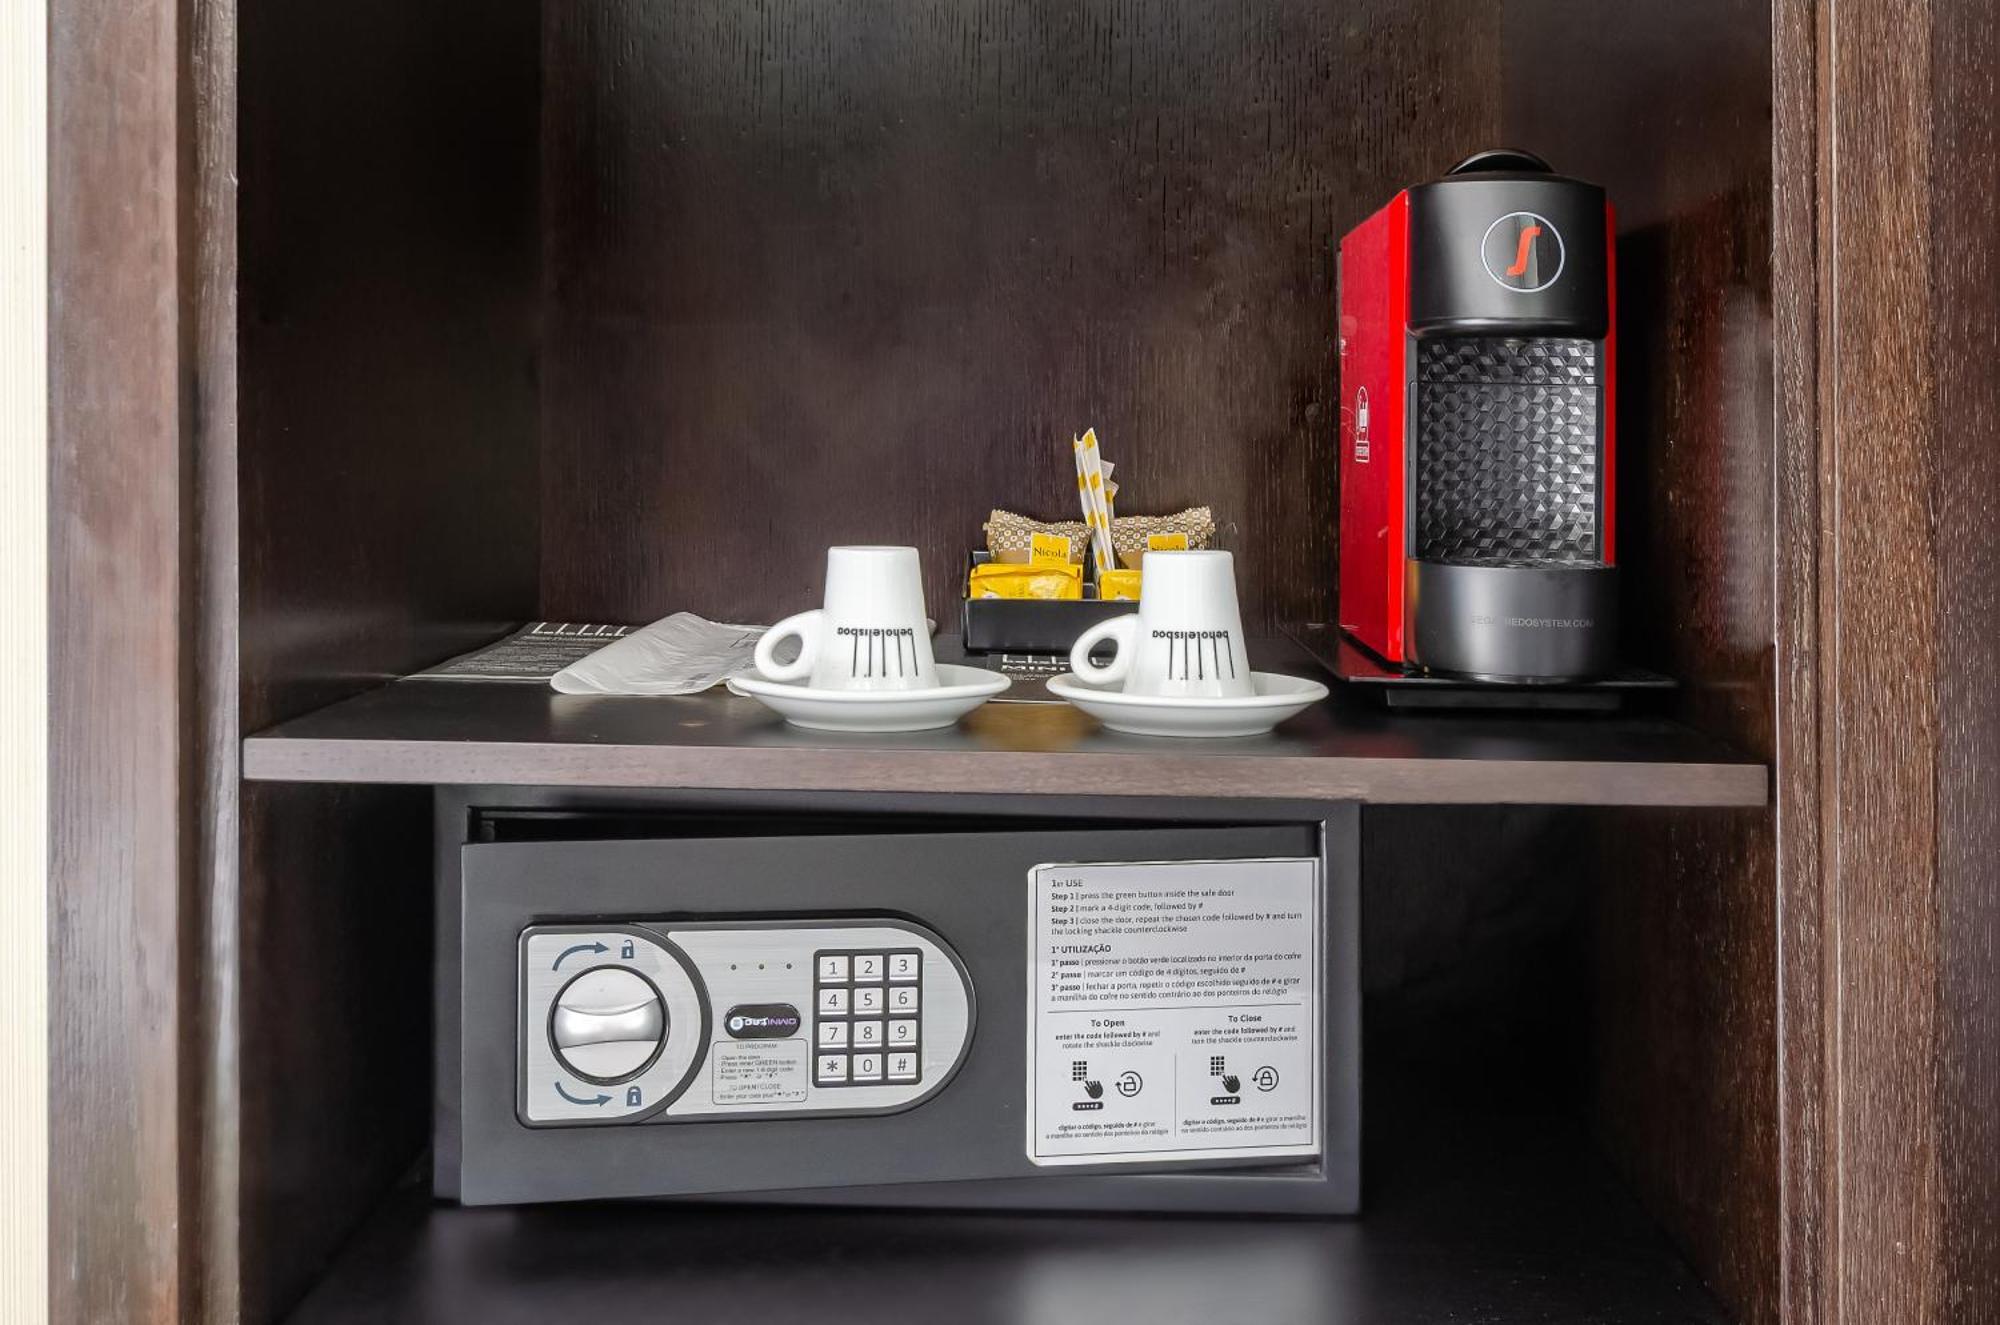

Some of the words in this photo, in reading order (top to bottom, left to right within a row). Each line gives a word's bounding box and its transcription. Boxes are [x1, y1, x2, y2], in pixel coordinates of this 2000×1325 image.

[1034, 547, 1067, 558] Nicola
[1108, 904, 1131, 912] 4-digit
[1136, 916, 1159, 924] repeat
[1256, 913, 1264, 921] by
[1065, 927, 1092, 936] locking
[1061, 944, 1111, 954] UTILIZAÇÃO
[1085, 958, 1120, 966] pressionar
[1255, 954, 1272, 962] porta
[829, 962, 837, 975] 1
[864, 960, 872, 973] 2
[899, 960, 907, 972] 3
[1129, 969, 1153, 977] código
[1201, 967, 1228, 975] seguido
[1060, 984, 1080, 992] passo
[1140, 981, 1163, 990] repetir
[1172, 980, 1195, 988] código
[1197, 979, 1231, 987] escolhido
[1131, 991, 1157, 999] sentido
[1159, 990, 1191, 998] contrário
[1217, 989, 1249, 997] ponteiros
[1262, 988, 1287, 996] relógio
[829, 994, 838, 1007] 4
[864, 993, 872, 1006] 5
[899, 992, 907, 1004] 6
[1104, 1020, 1124, 1028] Open
[829, 1027, 838, 1040] 7
[864, 1026, 872, 1039] 8
[898, 1026, 906, 1038] 9
[864, 1059, 872, 1072] 0
[898, 1058, 906, 1071] #
